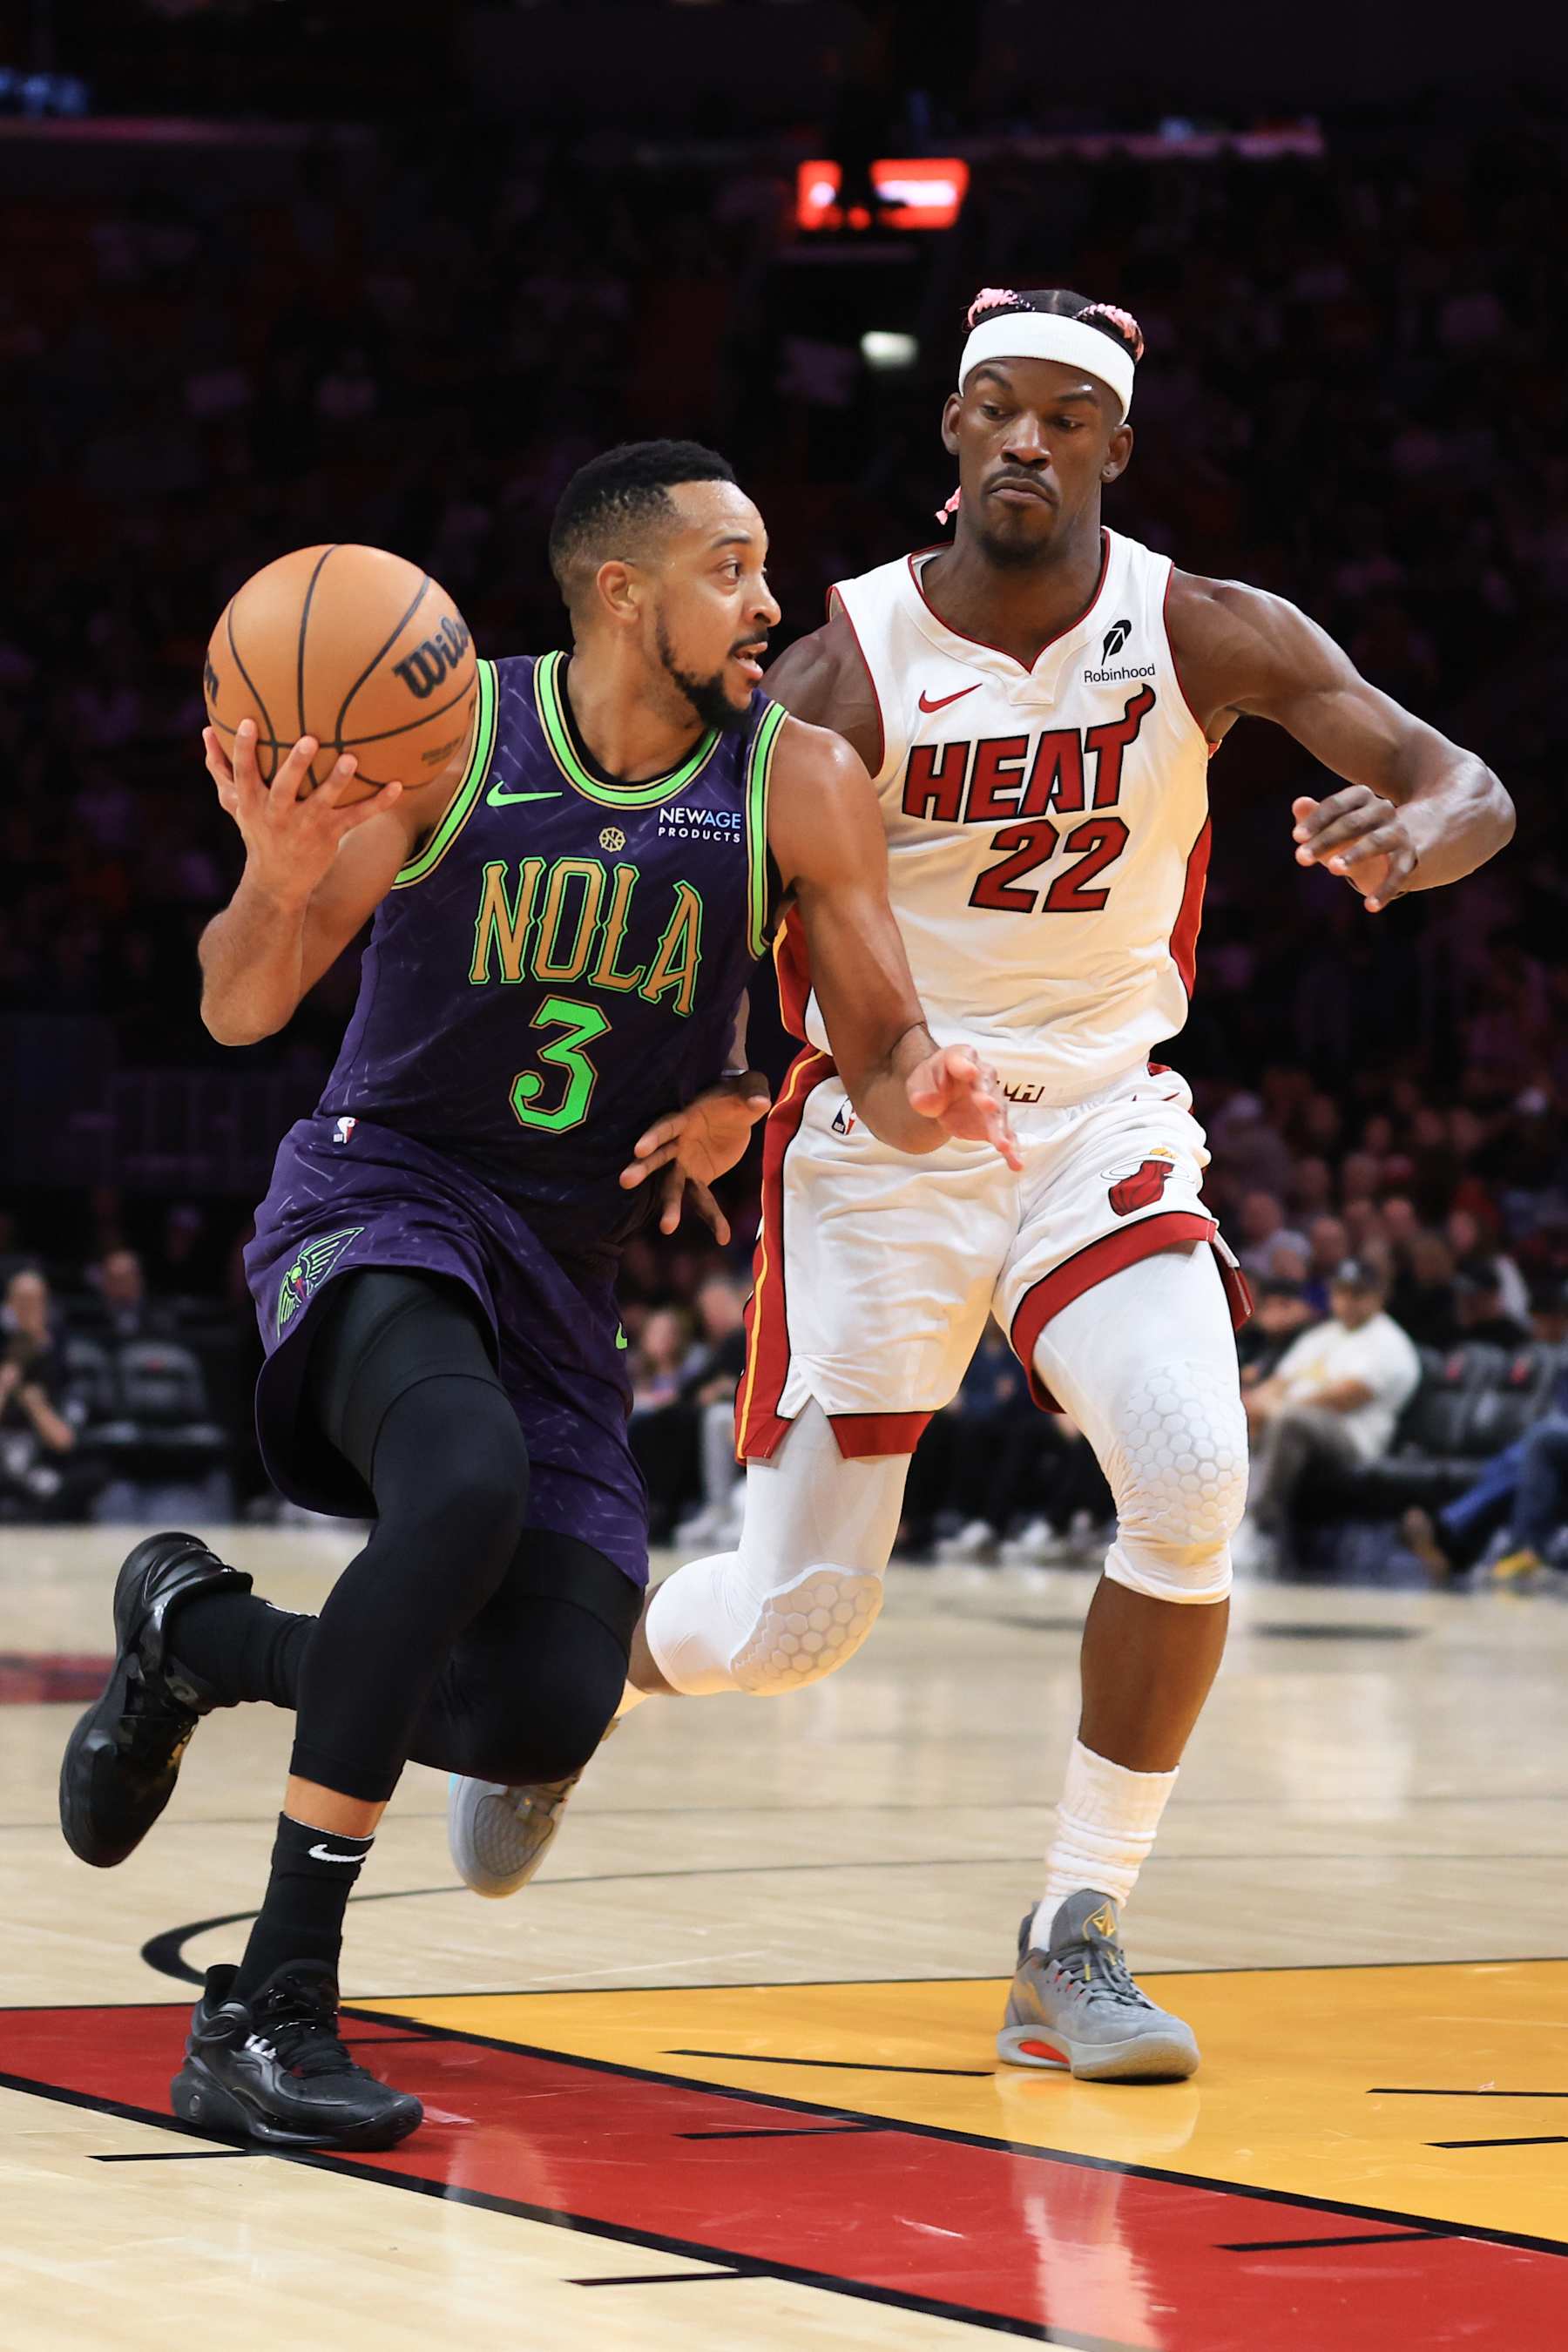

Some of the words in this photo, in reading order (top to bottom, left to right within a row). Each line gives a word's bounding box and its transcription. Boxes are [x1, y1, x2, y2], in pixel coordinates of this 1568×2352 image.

[1083, 663, 1155, 683] Robinhood
[902, 683, 1156, 823] HEAT
[658, 827, 740, 843] PRODUCTS
[659, 808, 741, 829] NEWAGE
[968, 817, 1130, 913] 22
[469, 857, 702, 1017] NOLA
[509, 995, 612, 1134] 3
